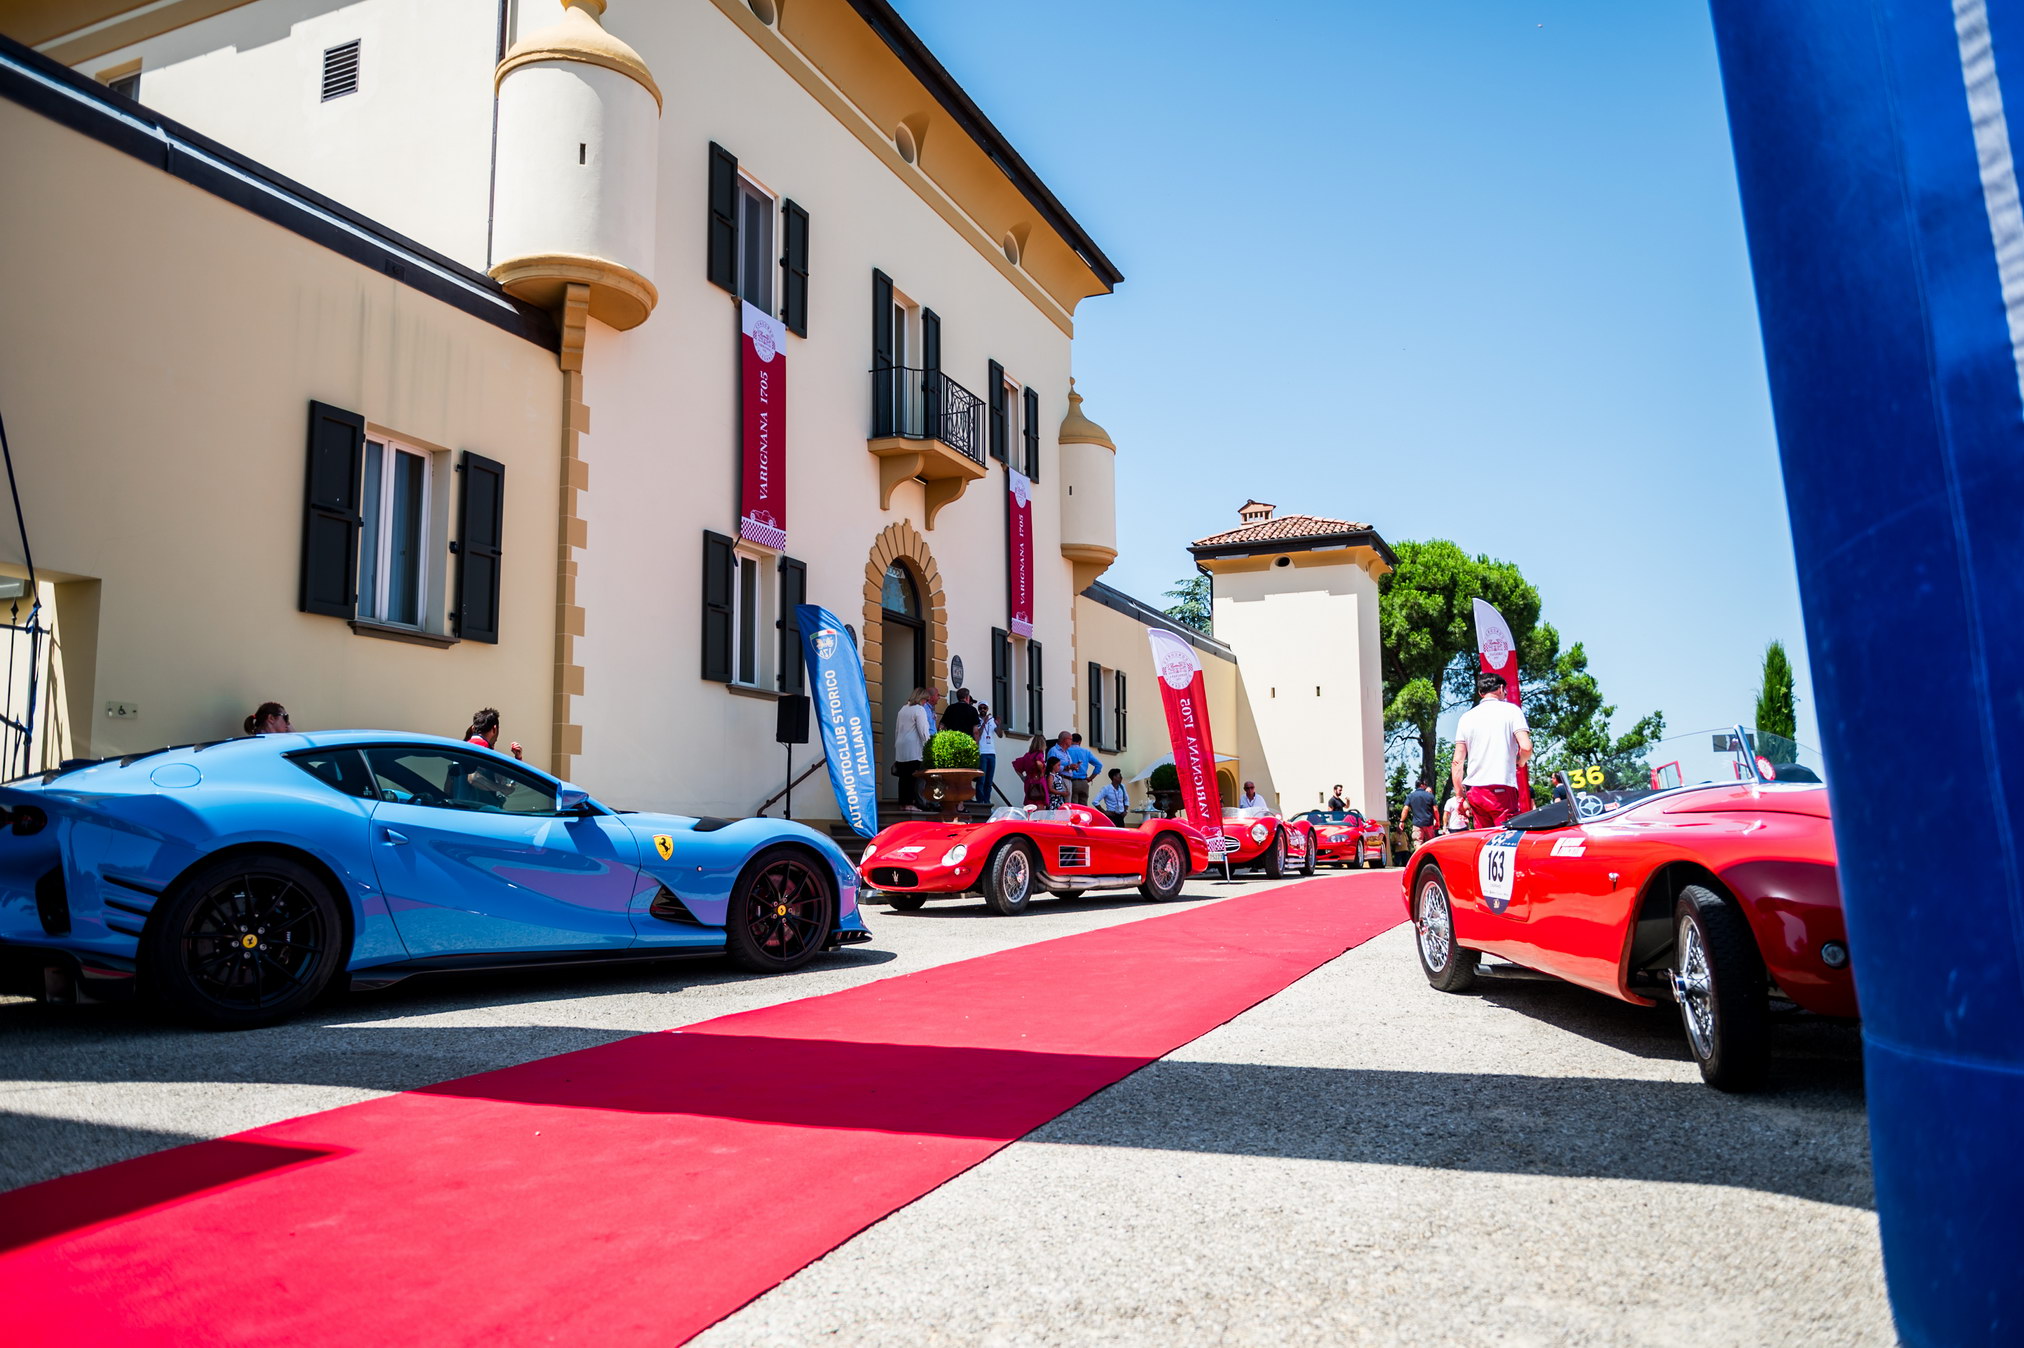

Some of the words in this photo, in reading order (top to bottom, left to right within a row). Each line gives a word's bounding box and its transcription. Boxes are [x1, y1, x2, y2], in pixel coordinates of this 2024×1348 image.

[760, 371, 768, 404] 1705
[760, 412, 768, 500] VARIGNANA
[825, 670, 844, 723] STORICO
[850, 716, 870, 776] ITALIANO
[834, 726, 864, 829] AUTOMOTOCLUB
[1568, 765, 1605, 789] 36
[1488, 850, 1505, 882] 163
